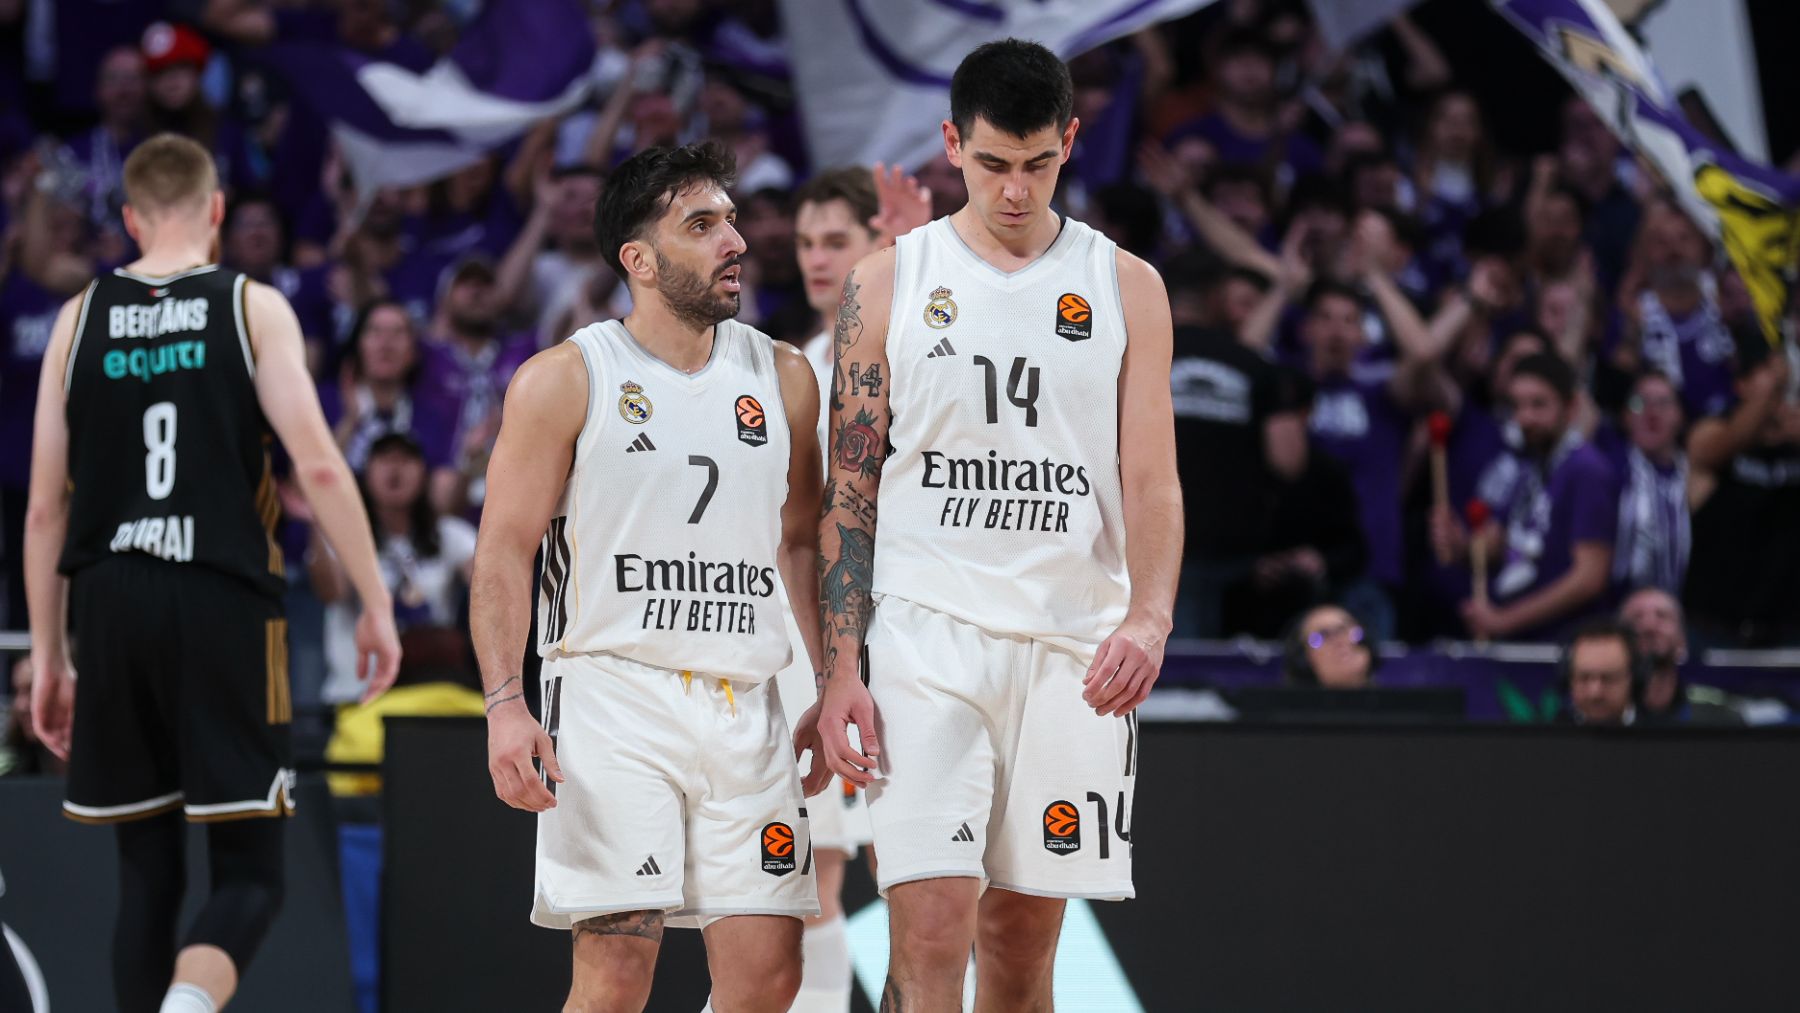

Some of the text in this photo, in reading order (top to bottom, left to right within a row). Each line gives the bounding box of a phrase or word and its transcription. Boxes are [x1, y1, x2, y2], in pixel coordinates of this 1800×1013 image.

[849, 362, 882, 397] 14
[973, 355, 1040, 427] 14
[143, 401, 177, 500] 8
[921, 450, 1090, 496] Emirates
[687, 455, 719, 524] 7
[940, 497, 1069, 532] FLY BETTER
[614, 551, 774, 598] Emirates
[642, 598, 755, 635] FLY BETTER
